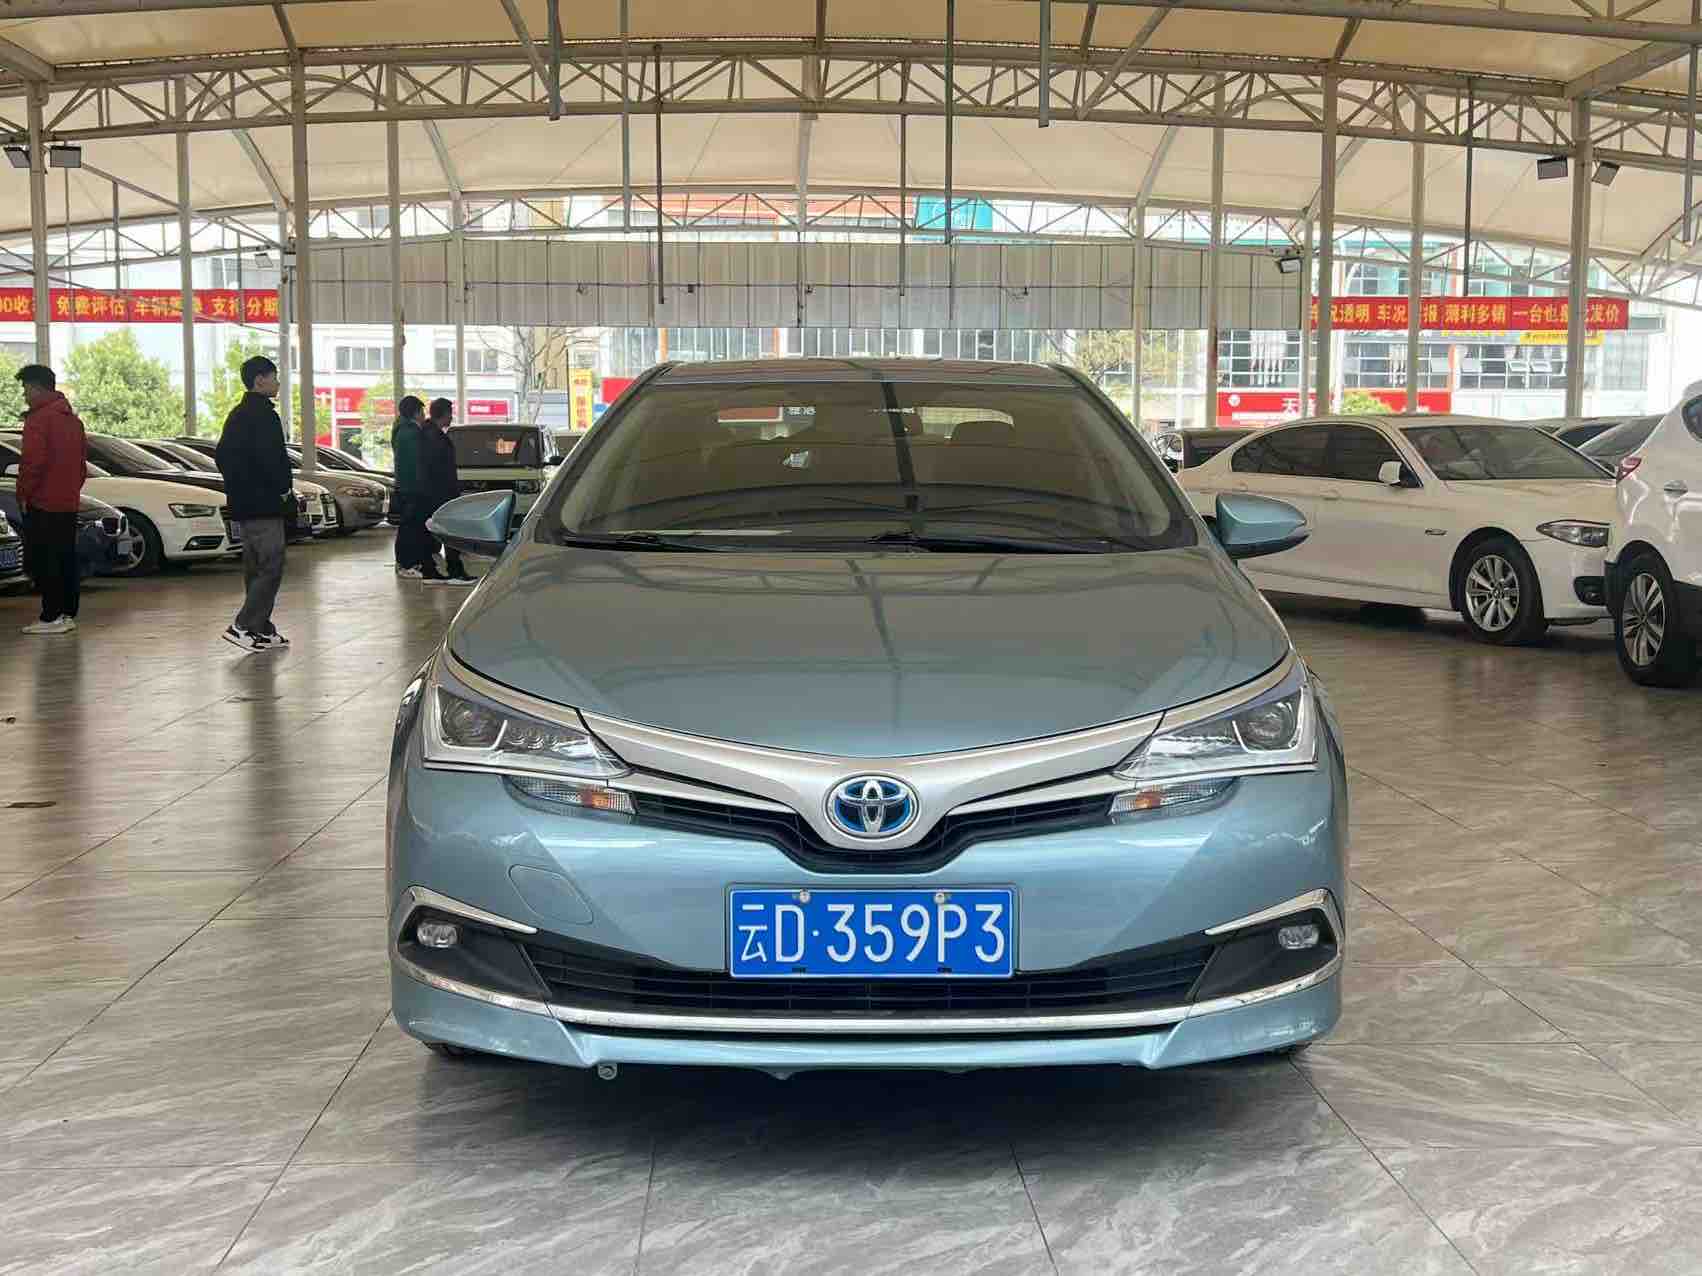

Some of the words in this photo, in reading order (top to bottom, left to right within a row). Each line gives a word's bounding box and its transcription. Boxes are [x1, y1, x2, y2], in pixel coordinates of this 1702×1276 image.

[56, 295, 125, 316] 免费评估
[1376, 303, 1438, 323] 车况报
